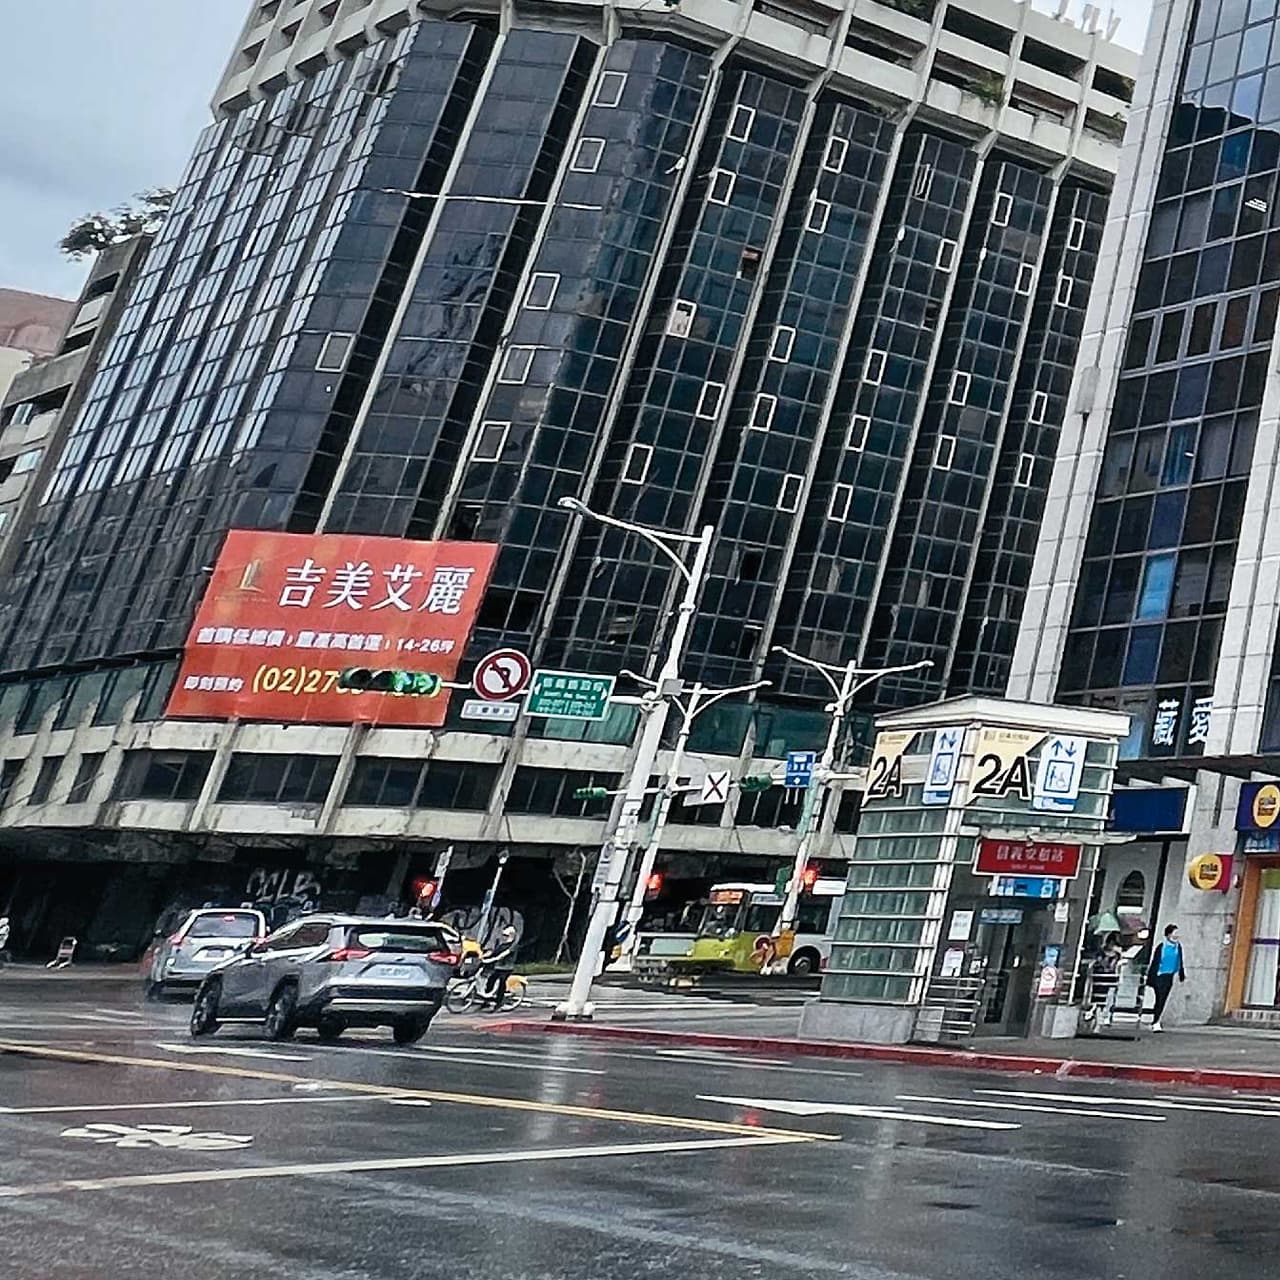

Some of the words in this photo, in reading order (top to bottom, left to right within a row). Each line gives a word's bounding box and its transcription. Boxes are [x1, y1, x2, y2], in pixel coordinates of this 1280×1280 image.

[278, 559, 475, 614] 吉美艾麗
[867, 754, 901, 796] 2A
[972, 753, 1029, 798] 2A
